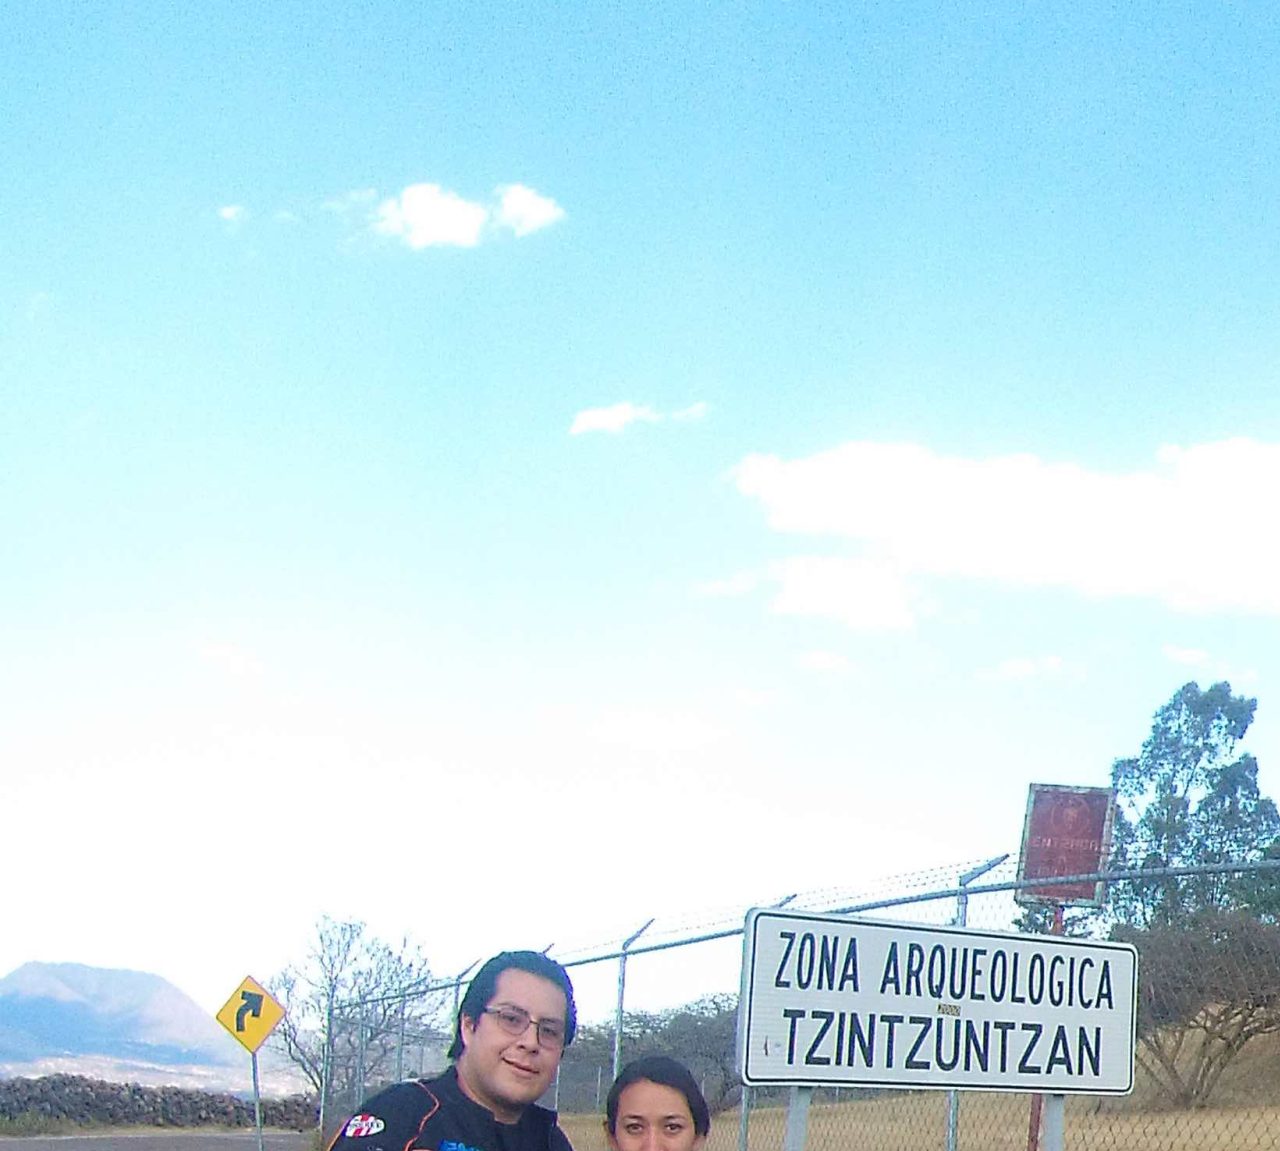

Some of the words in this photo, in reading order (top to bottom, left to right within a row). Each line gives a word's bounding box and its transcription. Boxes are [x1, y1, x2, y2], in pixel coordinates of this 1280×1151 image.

[775, 931, 860, 992] ZONA
[880, 941, 1114, 1010] ARQUEOLOGICA
[783, 1008, 1101, 1077] TZINTZUNTZAN
